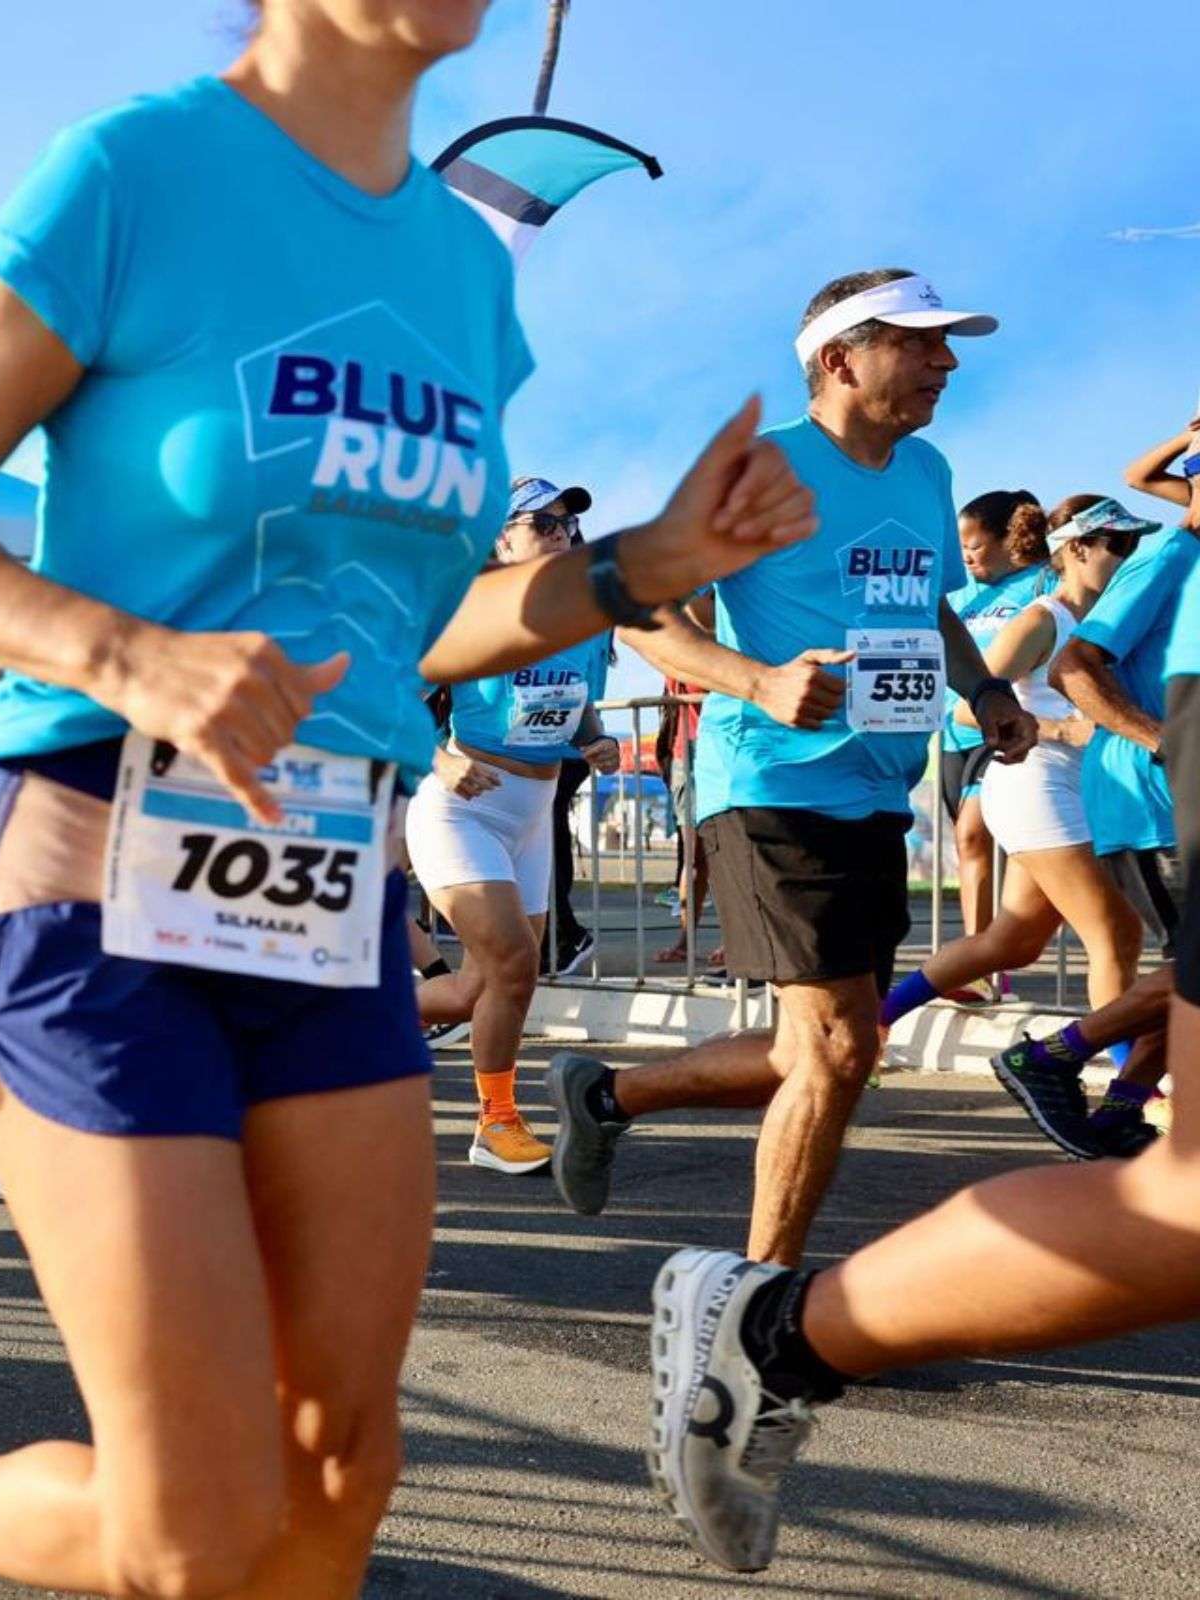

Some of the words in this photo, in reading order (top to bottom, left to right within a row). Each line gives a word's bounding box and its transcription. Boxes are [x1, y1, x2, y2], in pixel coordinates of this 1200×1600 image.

[268, 354, 484, 450] BLUE
[310, 416, 487, 519] RUN
[848, 547, 935, 577] BLUE
[863, 575, 931, 607] RUN
[512, 668, 582, 687] BLUE
[869, 672, 936, 702] 5339
[172, 834, 359, 913] 1035
[214, 911, 308, 936] SILMARA
